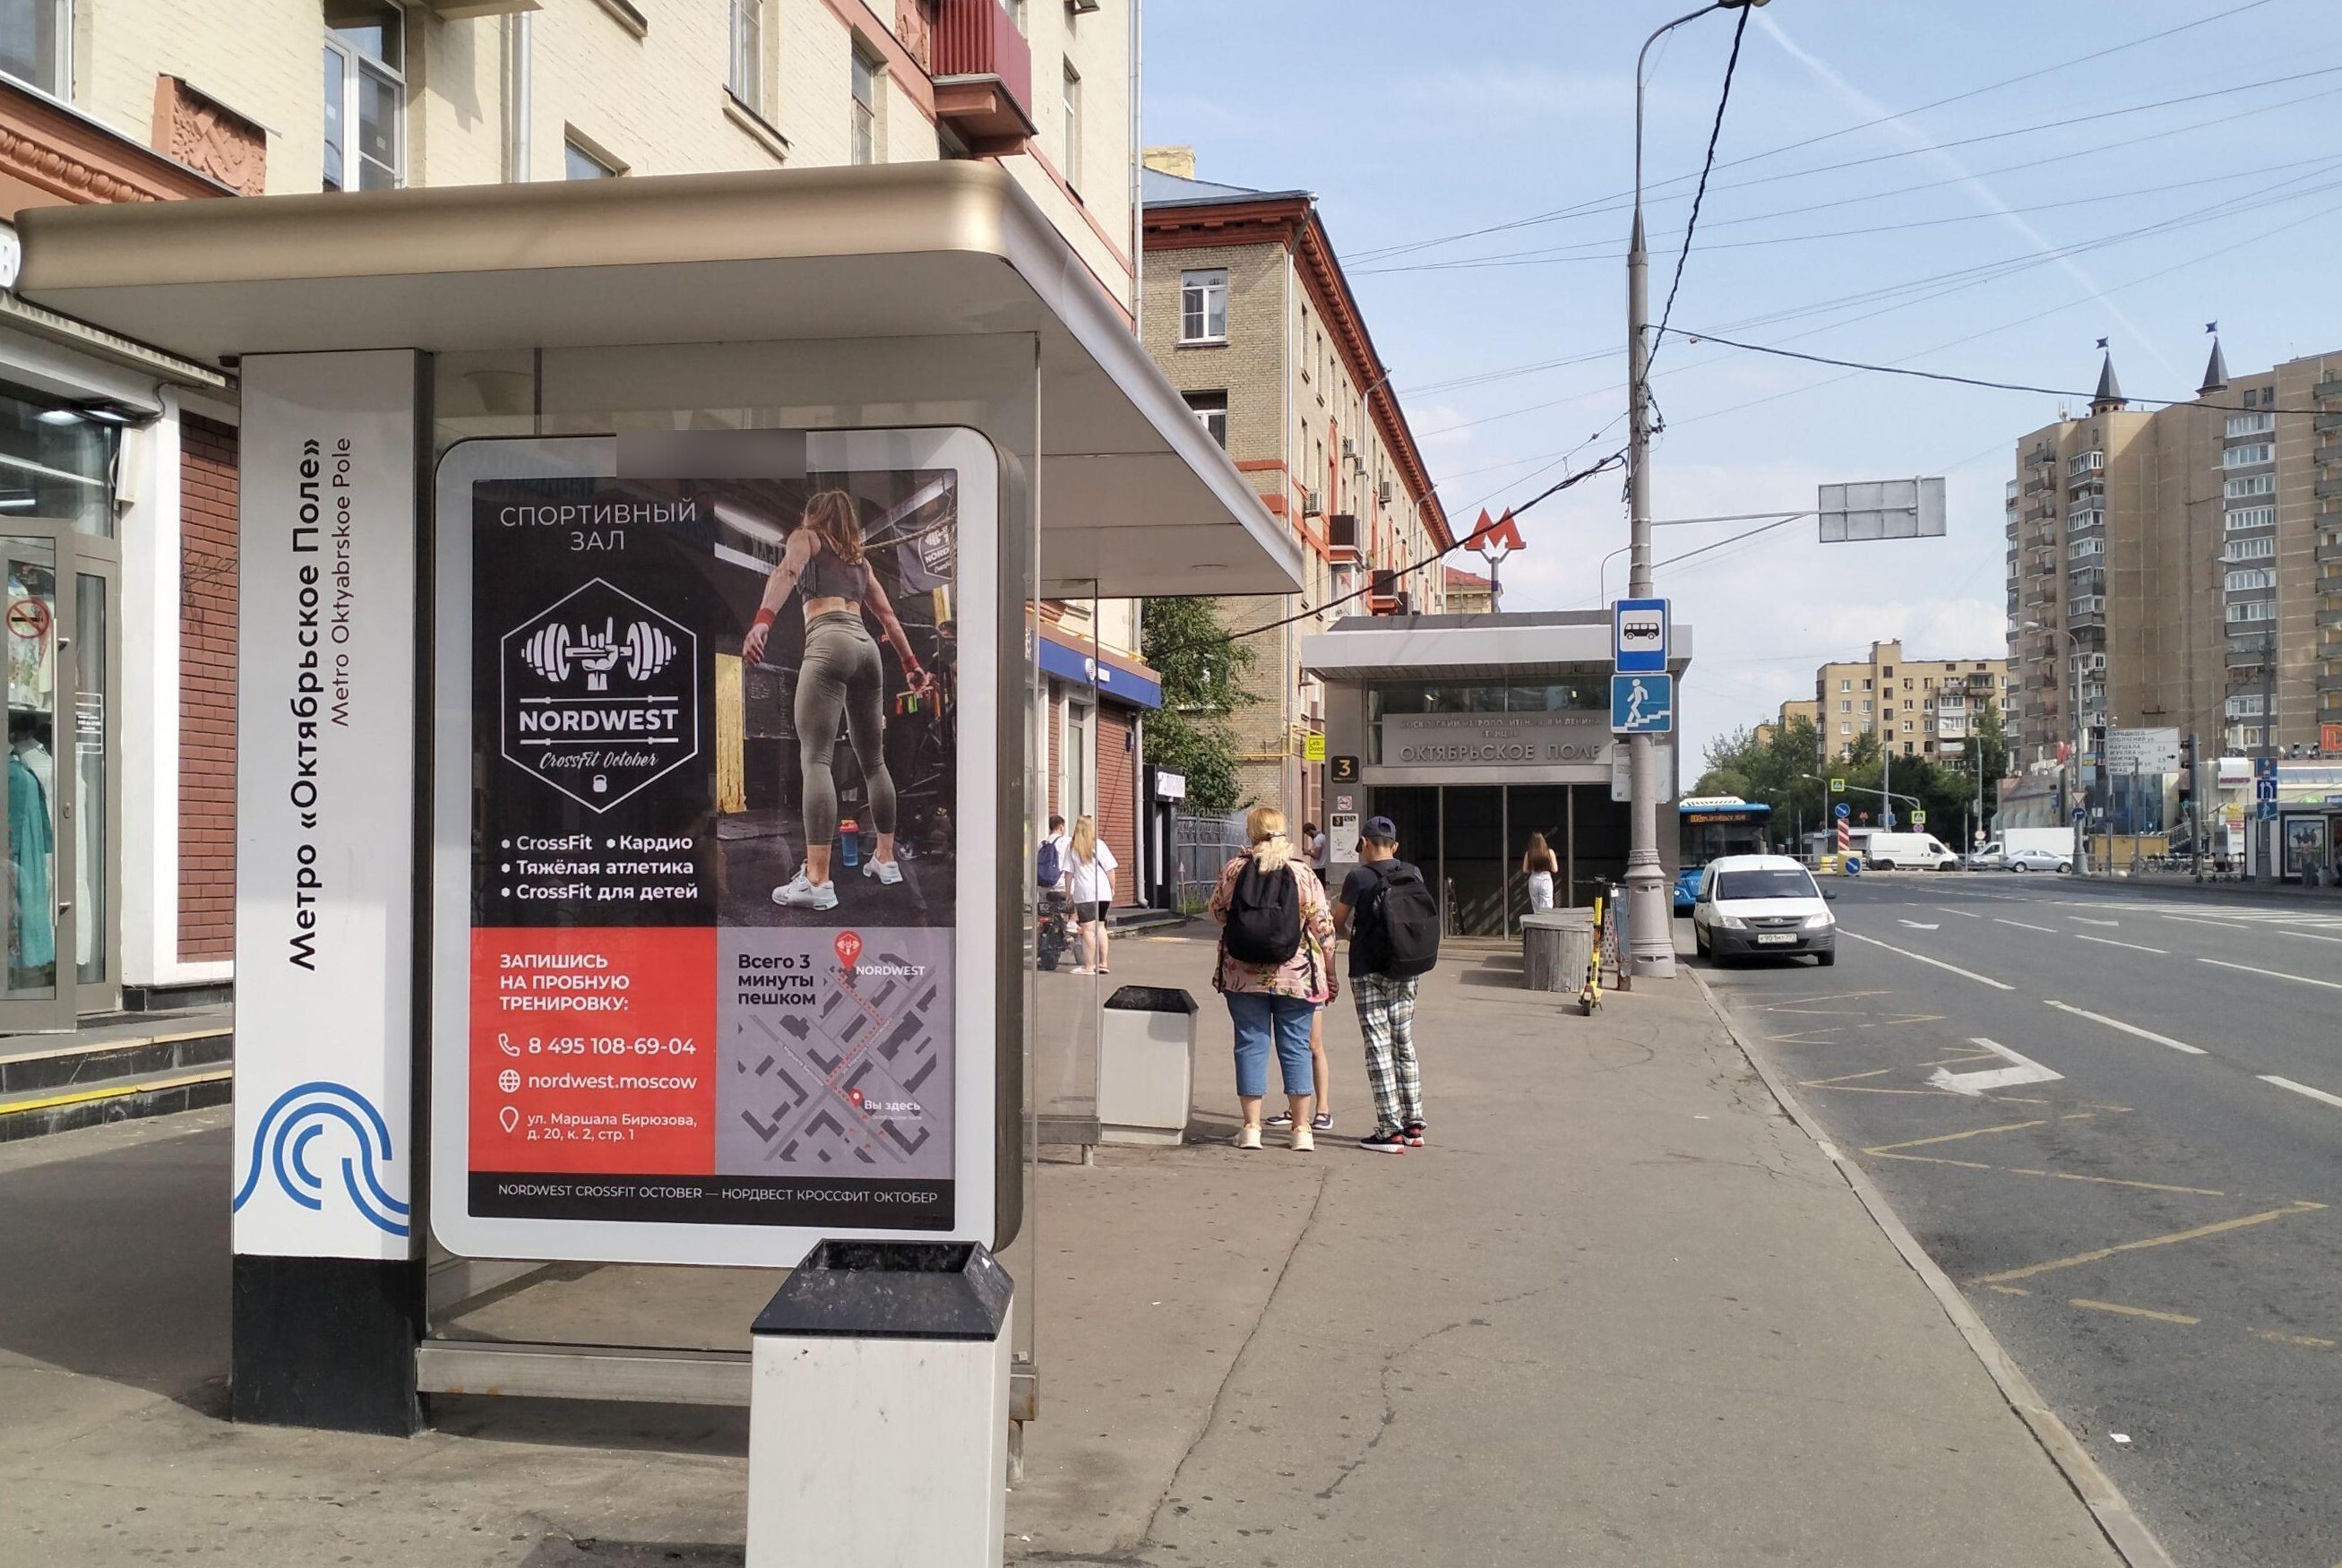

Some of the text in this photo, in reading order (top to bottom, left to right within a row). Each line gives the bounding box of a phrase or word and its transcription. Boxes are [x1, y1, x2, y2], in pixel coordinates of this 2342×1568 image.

[500, 497, 696, 527] СПОРТИВНЫЙ
[570, 530, 624, 551] ЗАЛ
[331, 437, 354, 727] Metro Oktyabrskoe Pole
[289, 438, 324, 971] Метро «Октябрьское Поле»
[519, 709, 679, 731] NORDWEST
[539, 751, 659, 770] CrossFit October
[1399, 745, 1600, 762] ОКТЯБРЬСКОЕ ПОЛЕ
[1339, 759, 1351, 777] 3
[516, 834, 593, 851] CrossFit
[619, 835, 693, 853] Кардио
[516, 859, 694, 874] Тяжёлая атлетика
[516, 883, 699, 901] CrossFit для детей
[500, 953, 608, 969] ЗАПИШИСЬ
[737, 954, 811, 970] Всего 3
[856, 965, 926, 977] NORDWEST
[500, 975, 630, 990] НА ПРОБНУЮ
[737, 974, 814, 990] минуты
[499, 996, 629, 1012] ТРЕНИРОВКУ:
[737, 993, 816, 1005] пешком
[528, 1038, 697, 1055] 8 495 108-69-04
[528, 1073, 698, 1090] nordwest.moscow
[864, 1099, 922, 1112] Вы здесь
[527, 1113, 698, 1128] ул. Маршала Бирюзова,
[527, 1128, 635, 1143] д. 20, к. 2, стр. 1
[498, 1184, 573, 1196] NORDWEST
[575, 1185, 636, 1198] CROSSFIT
[639, 1186, 702, 1199] OCTOBER
[721, 1188, 794, 1202] НОРДВЕСТ
[796, 1189, 871, 1202] КРОССФИТ
[874, 1191, 938, 1203] ОКТОБЕР
